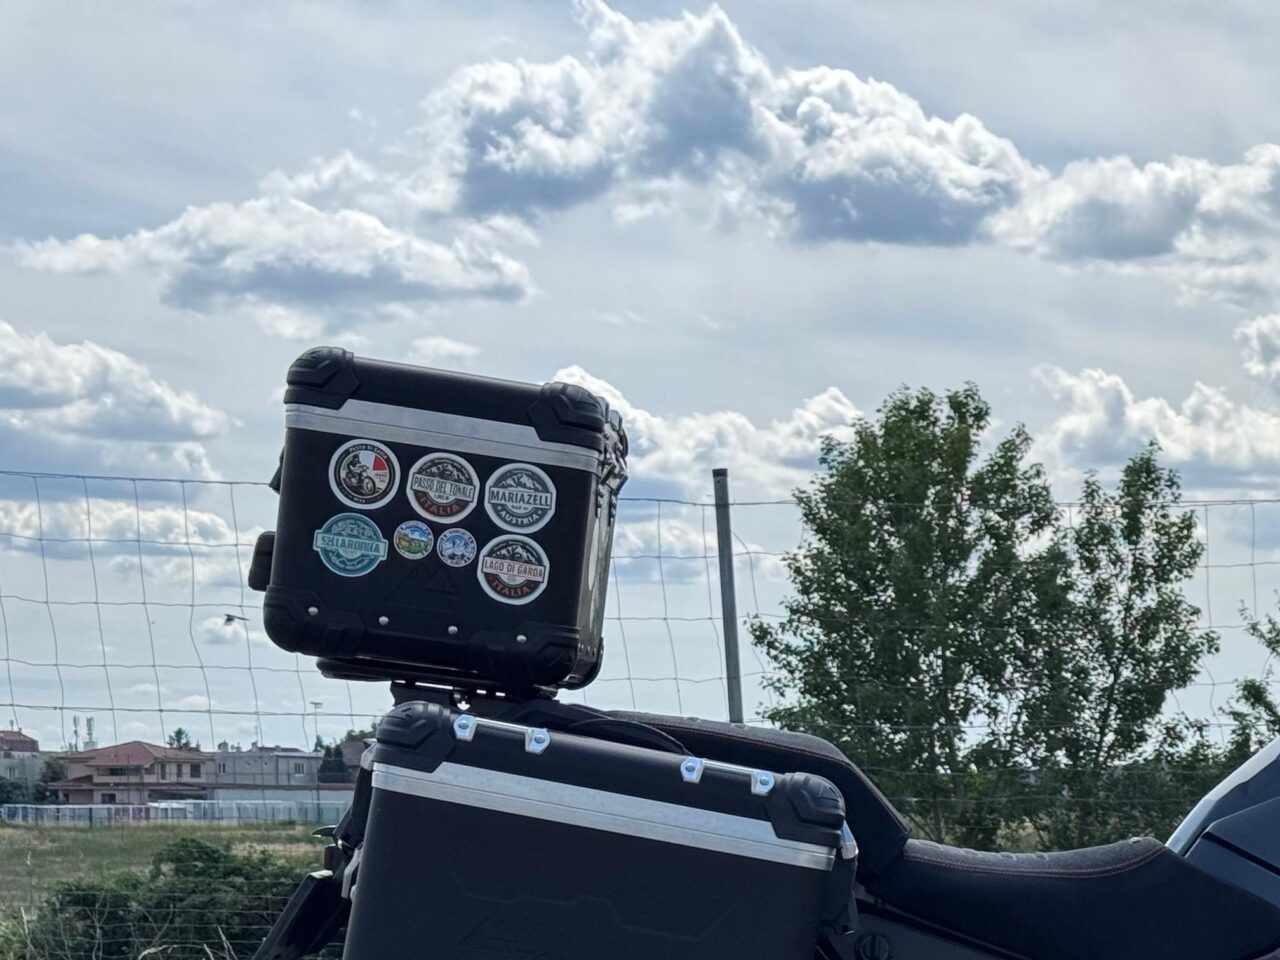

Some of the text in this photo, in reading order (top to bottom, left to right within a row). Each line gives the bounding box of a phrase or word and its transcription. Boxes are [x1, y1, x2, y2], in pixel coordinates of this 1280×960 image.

[413, 476, 434, 492] PASSO
[435, 480, 447, 494] DEL
[448, 482, 473, 498] TONALE
[420, 497, 460, 515] ITALIA
[490, 490, 550, 507] MARIAZELL
[499, 510, 540, 525] AUSTRIA
[484, 560, 504, 572] LAGO
[506, 564, 515, 573] DI
[517, 565, 543, 578] GARDA
[491, 580, 530, 597] ITALIA
